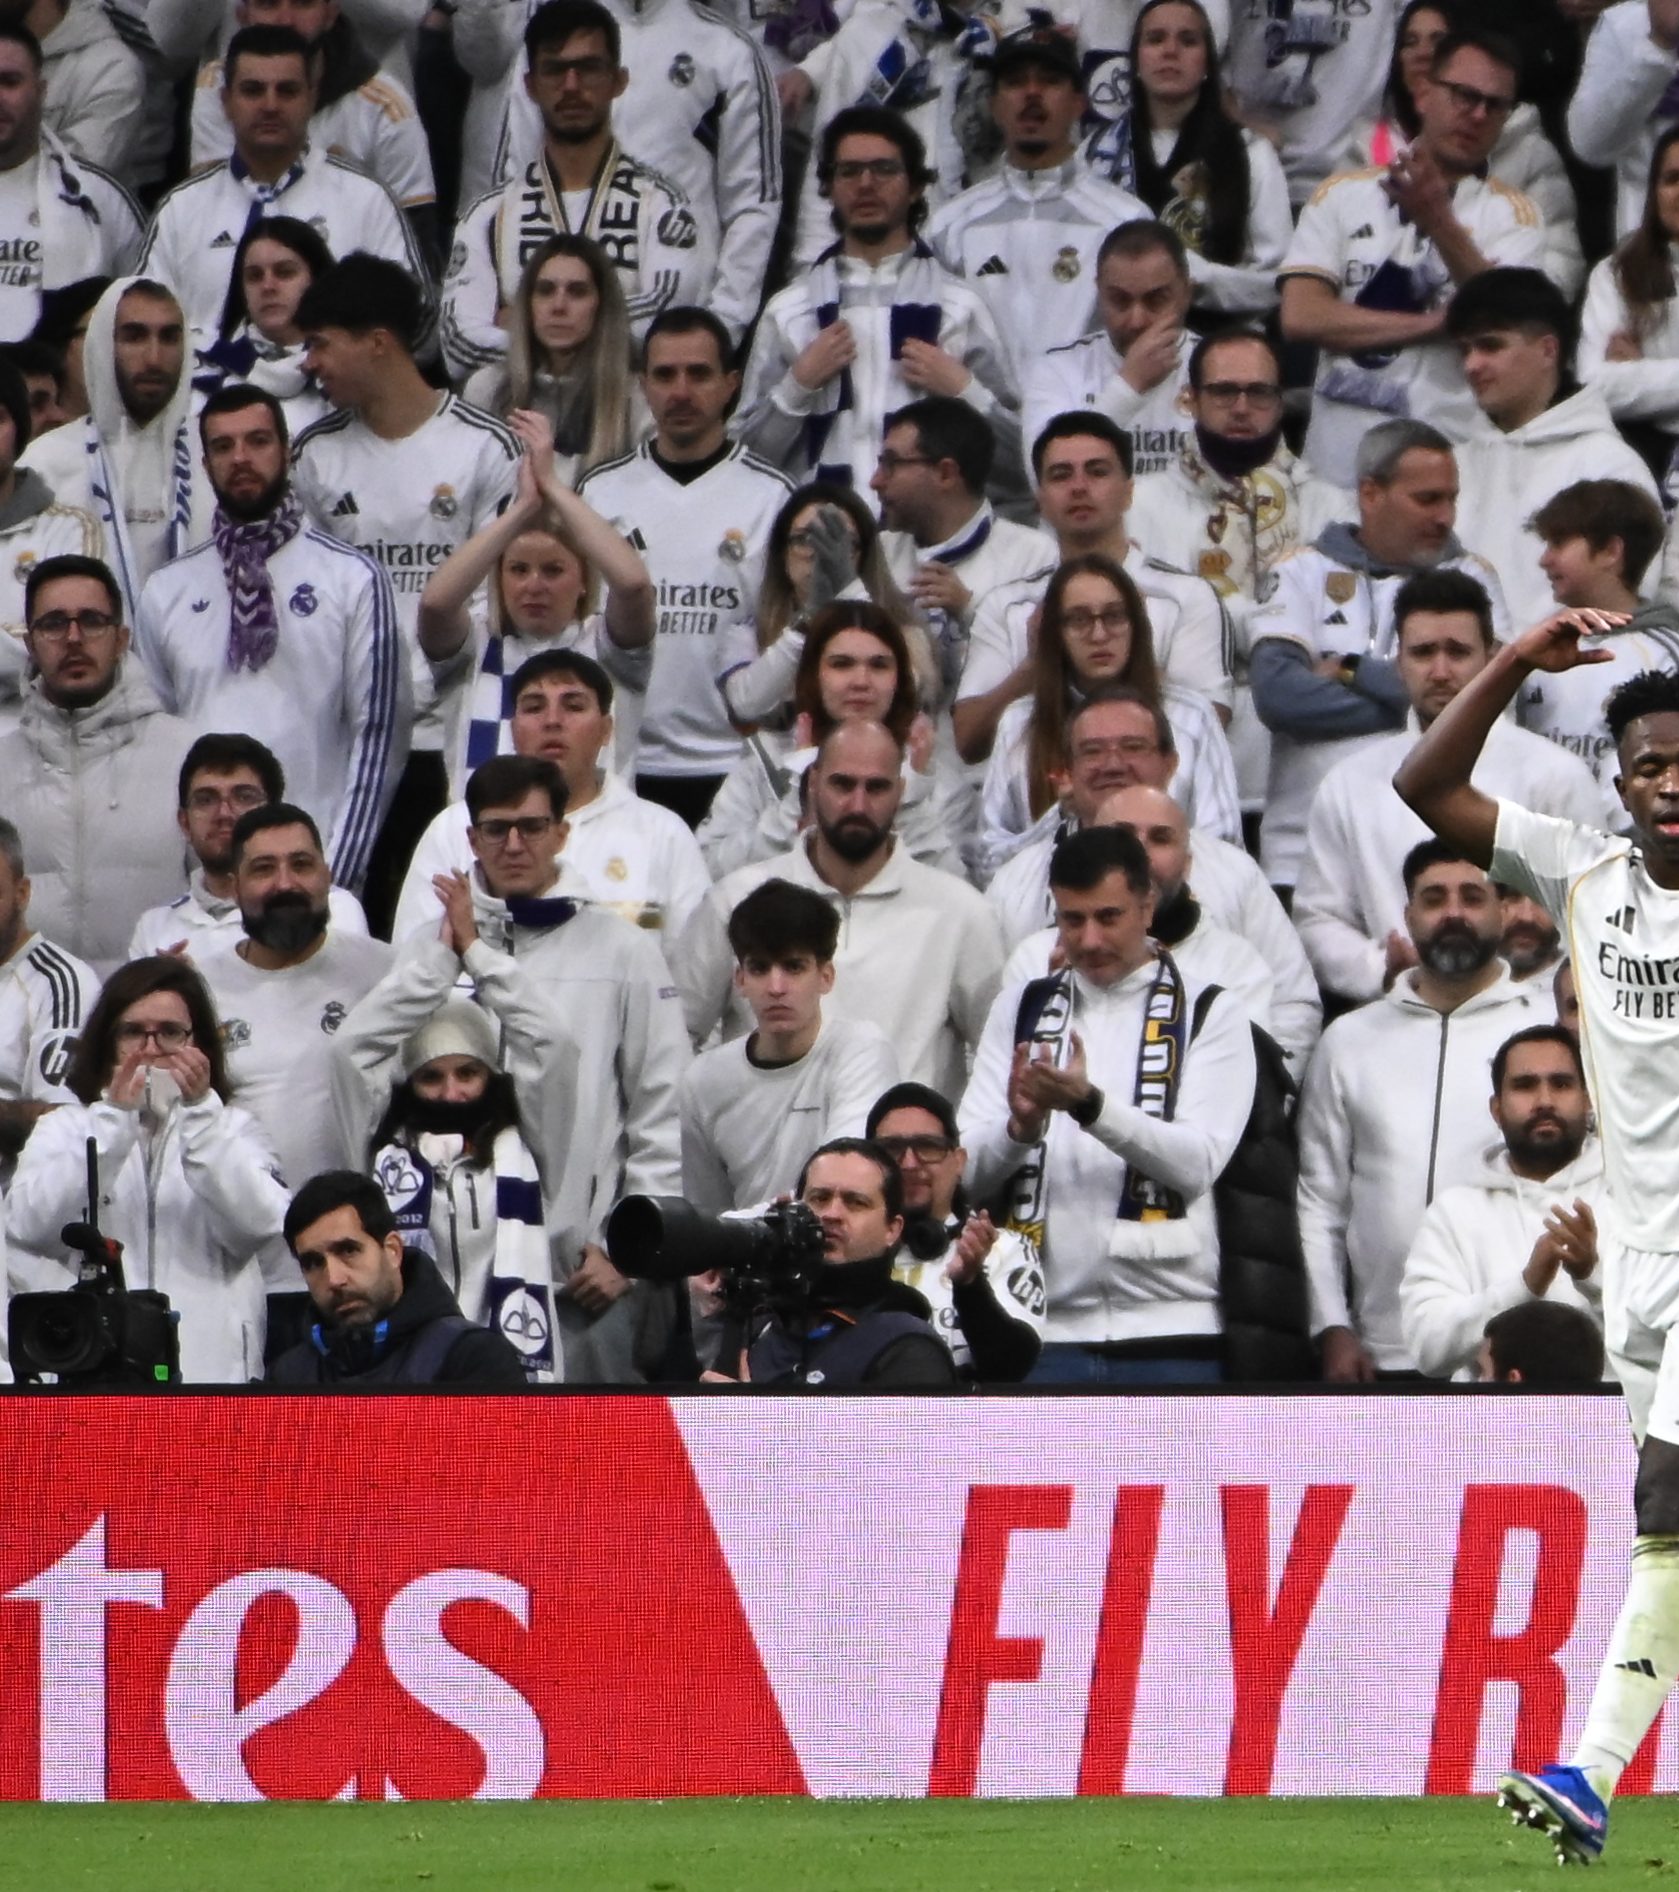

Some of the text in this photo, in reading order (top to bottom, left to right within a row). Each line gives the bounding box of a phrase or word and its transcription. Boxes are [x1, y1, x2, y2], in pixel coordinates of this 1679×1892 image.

[652, 578, 740, 610] irates
[659, 611, 718, 635] BETTER
[1612, 989, 1644, 1019] FLY
